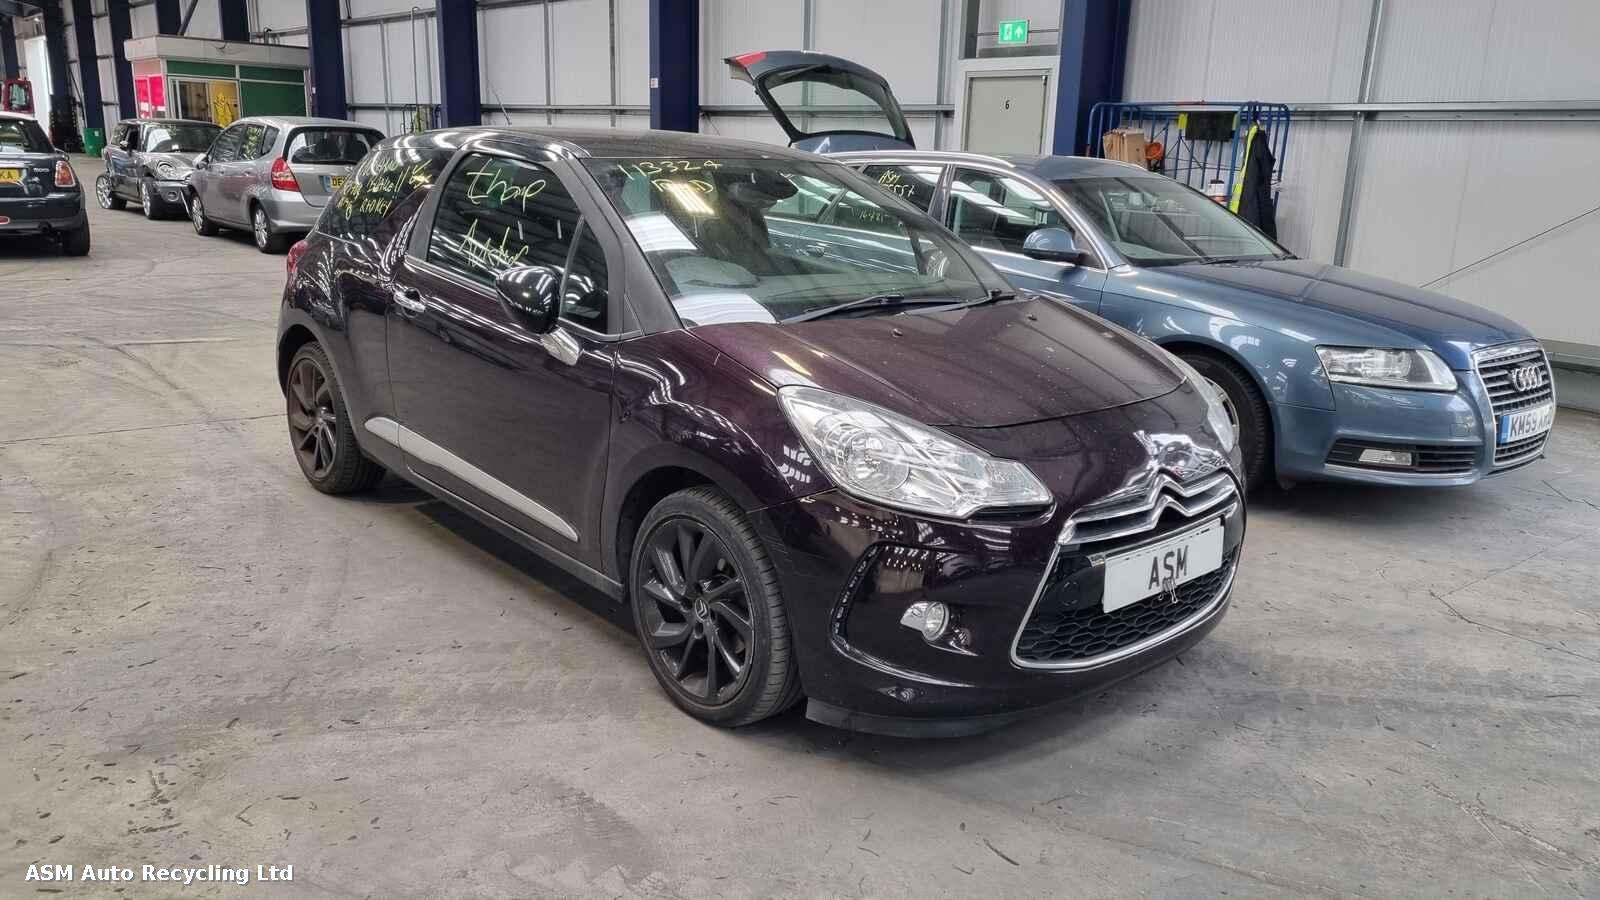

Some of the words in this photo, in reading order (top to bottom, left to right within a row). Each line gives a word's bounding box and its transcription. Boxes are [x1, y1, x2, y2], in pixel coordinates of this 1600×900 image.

[1005, 99, 1010, 110] 6
[1511, 411, 1537, 437] KM59
[1148, 545, 1189, 590] ASM
